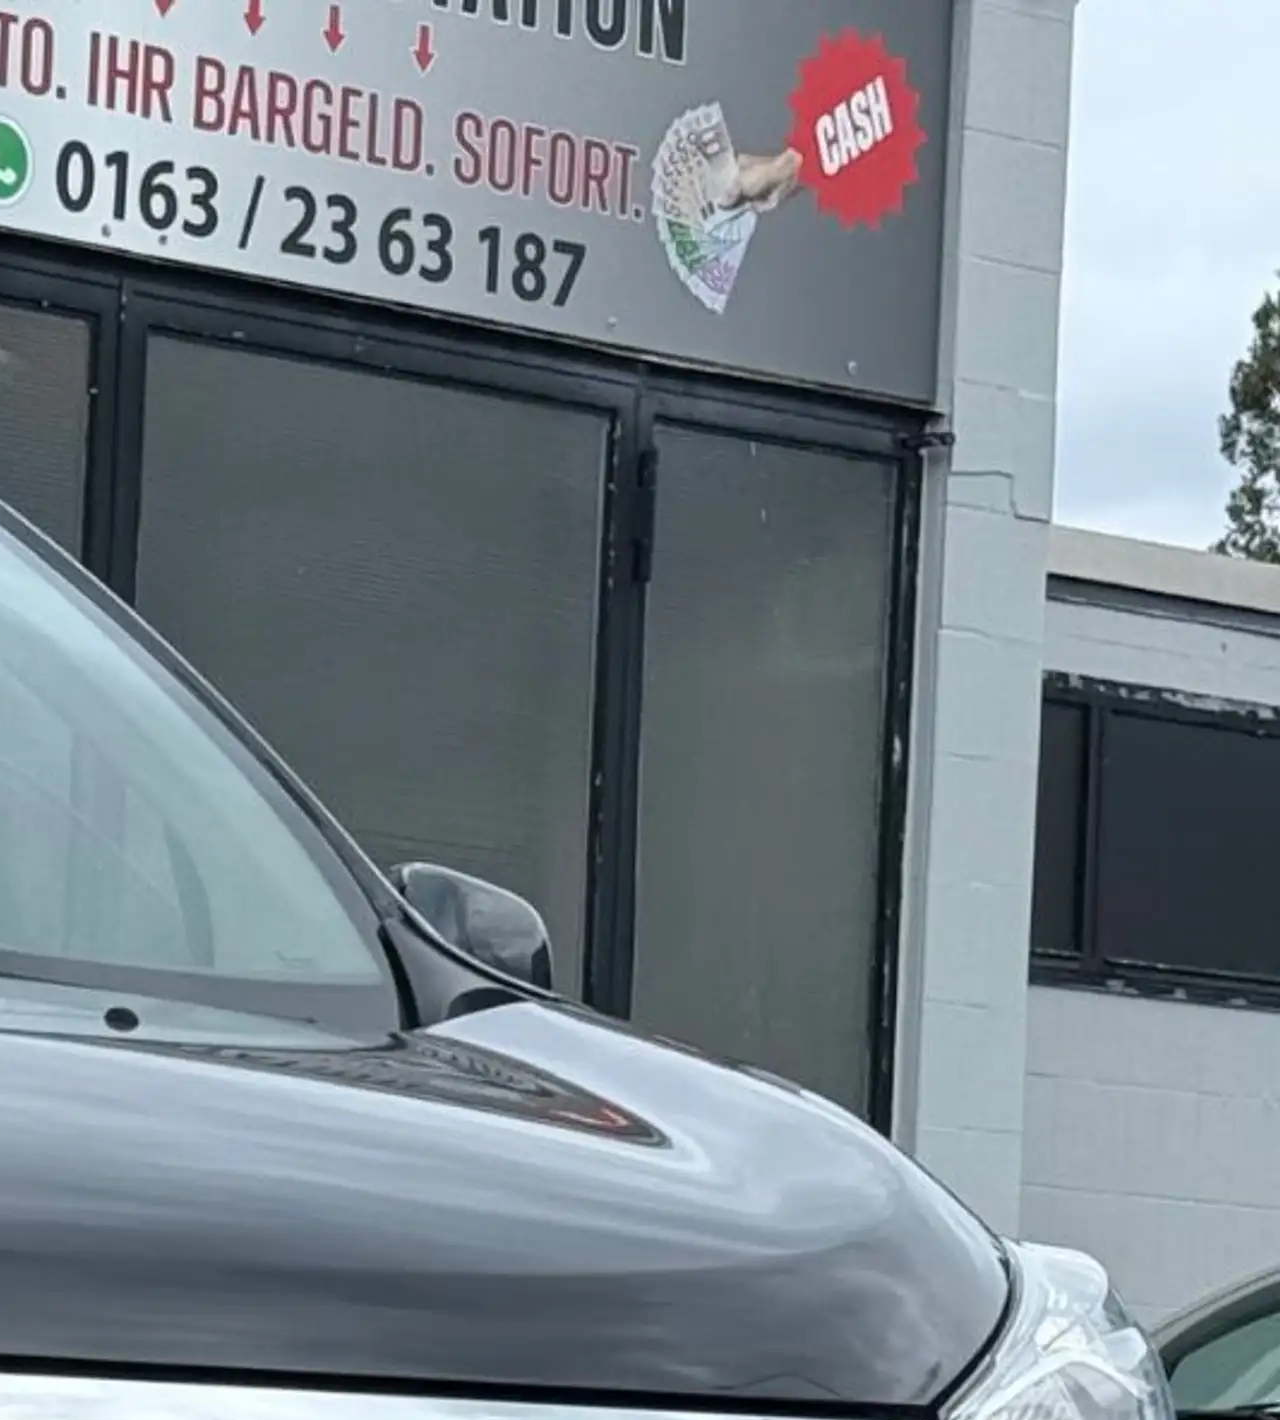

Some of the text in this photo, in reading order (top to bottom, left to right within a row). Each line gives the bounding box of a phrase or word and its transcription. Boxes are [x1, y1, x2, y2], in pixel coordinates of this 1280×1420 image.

[87, 31, 175, 123] IHR
[193, 55, 435, 176] BARGELD.
[454, 112, 644, 220] SOFORT.
[814, 75, 894, 177] CASH
[55, 139, 219, 238] 0163
[279, 185, 358, 265] 23
[377, 207, 454, 283] 63
[477, 225, 588, 307] 187
